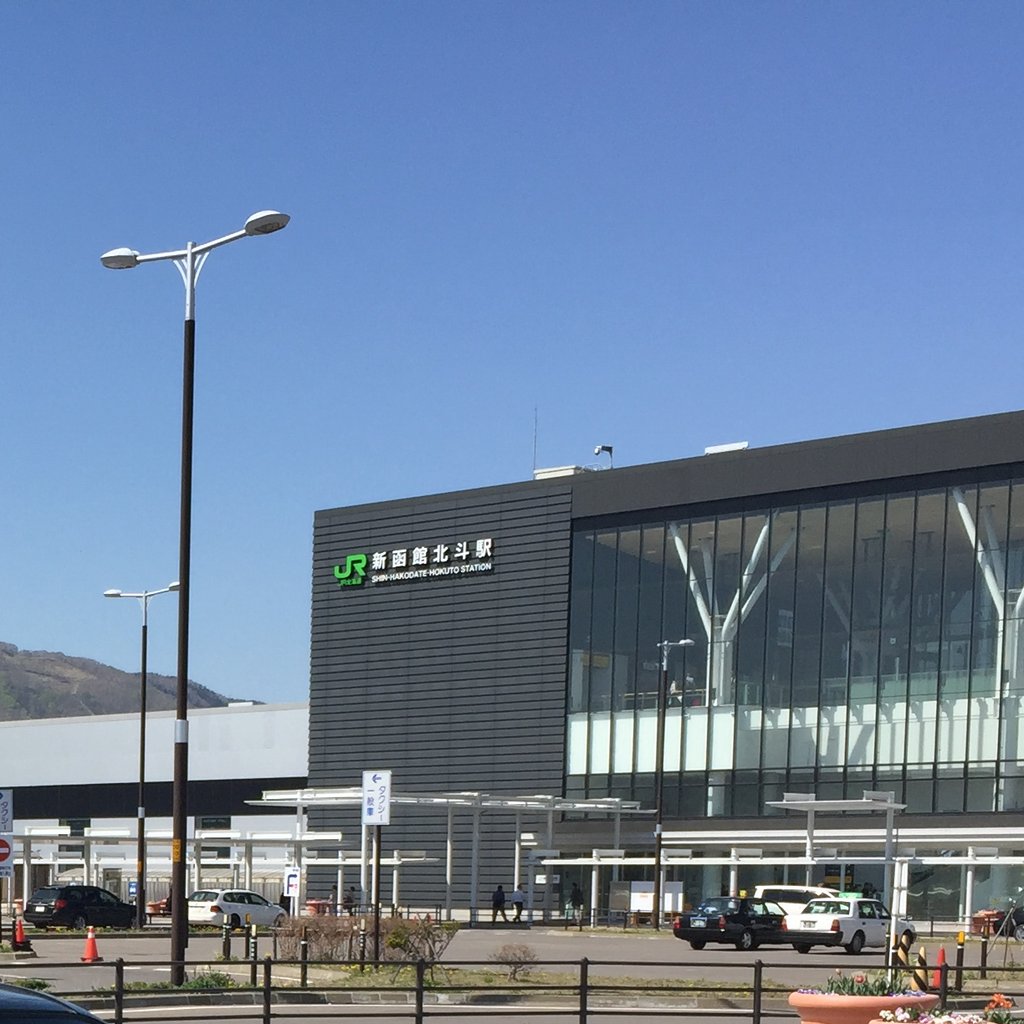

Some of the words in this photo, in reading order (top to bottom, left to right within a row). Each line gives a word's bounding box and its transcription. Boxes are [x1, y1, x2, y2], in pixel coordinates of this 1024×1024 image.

[334, 553, 366, 579] JR
[371, 538, 492, 570] 新函館北斗駅
[371, 566, 460, 583] SHIN-HAKODATE-HOKUTO
[460, 563, 492, 574] STATION
[0, 801, 9, 830] タクシー
[378, 785, 387, 822] タクシー
